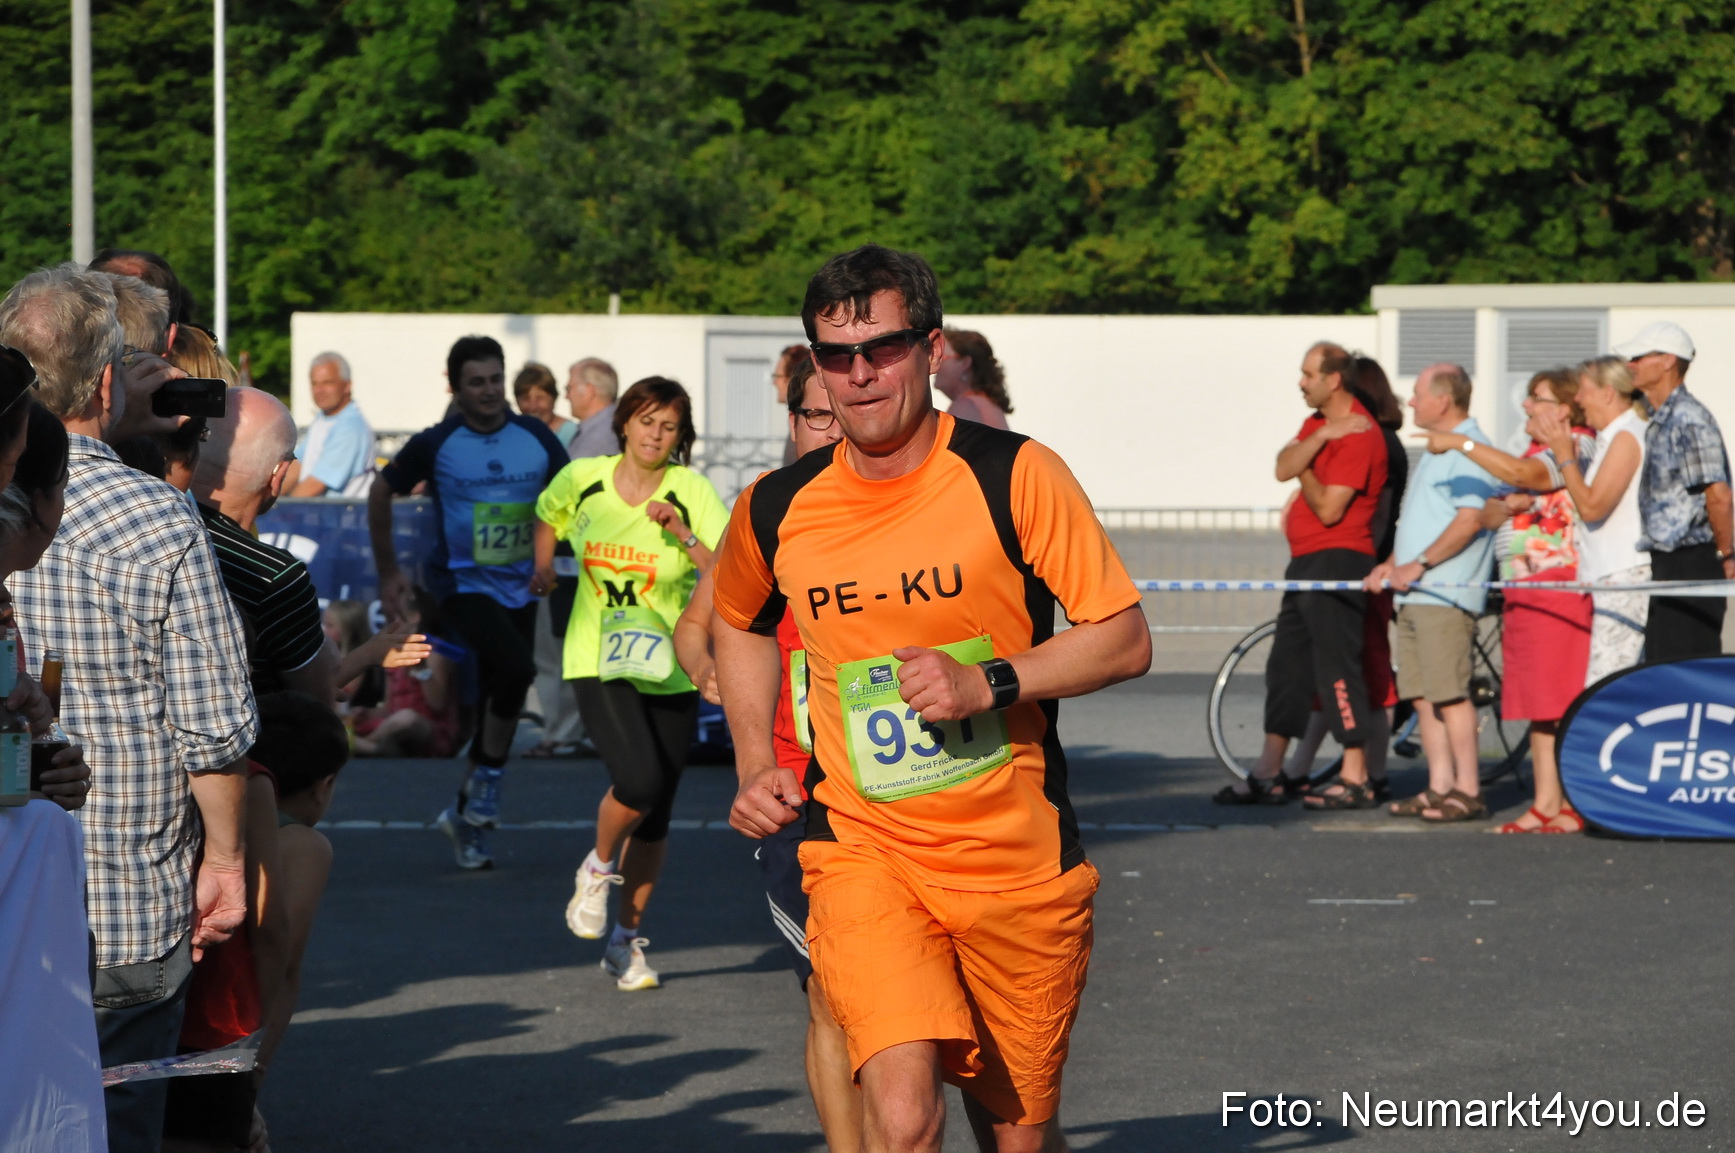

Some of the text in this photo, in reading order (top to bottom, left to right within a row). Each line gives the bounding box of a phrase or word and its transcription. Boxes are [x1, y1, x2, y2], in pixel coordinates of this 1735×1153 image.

[583, 541, 660, 565] Müller
[602, 580, 639, 608] M
[807, 581, 863, 620] PE
[901, 563, 963, 605] KU
[607, 631, 663, 662] 277
[862, 678, 900, 695] firmenl
[864, 772, 941, 793] PE-Kunststoff-Fabrik
[942, 756, 983, 777] Woffenbach
[983, 747, 1004, 762] GmbH
[910, 759, 932, 772] Gerd
[933, 753, 959, 769] Fricke
[1648, 741, 1735, 783] Fis
